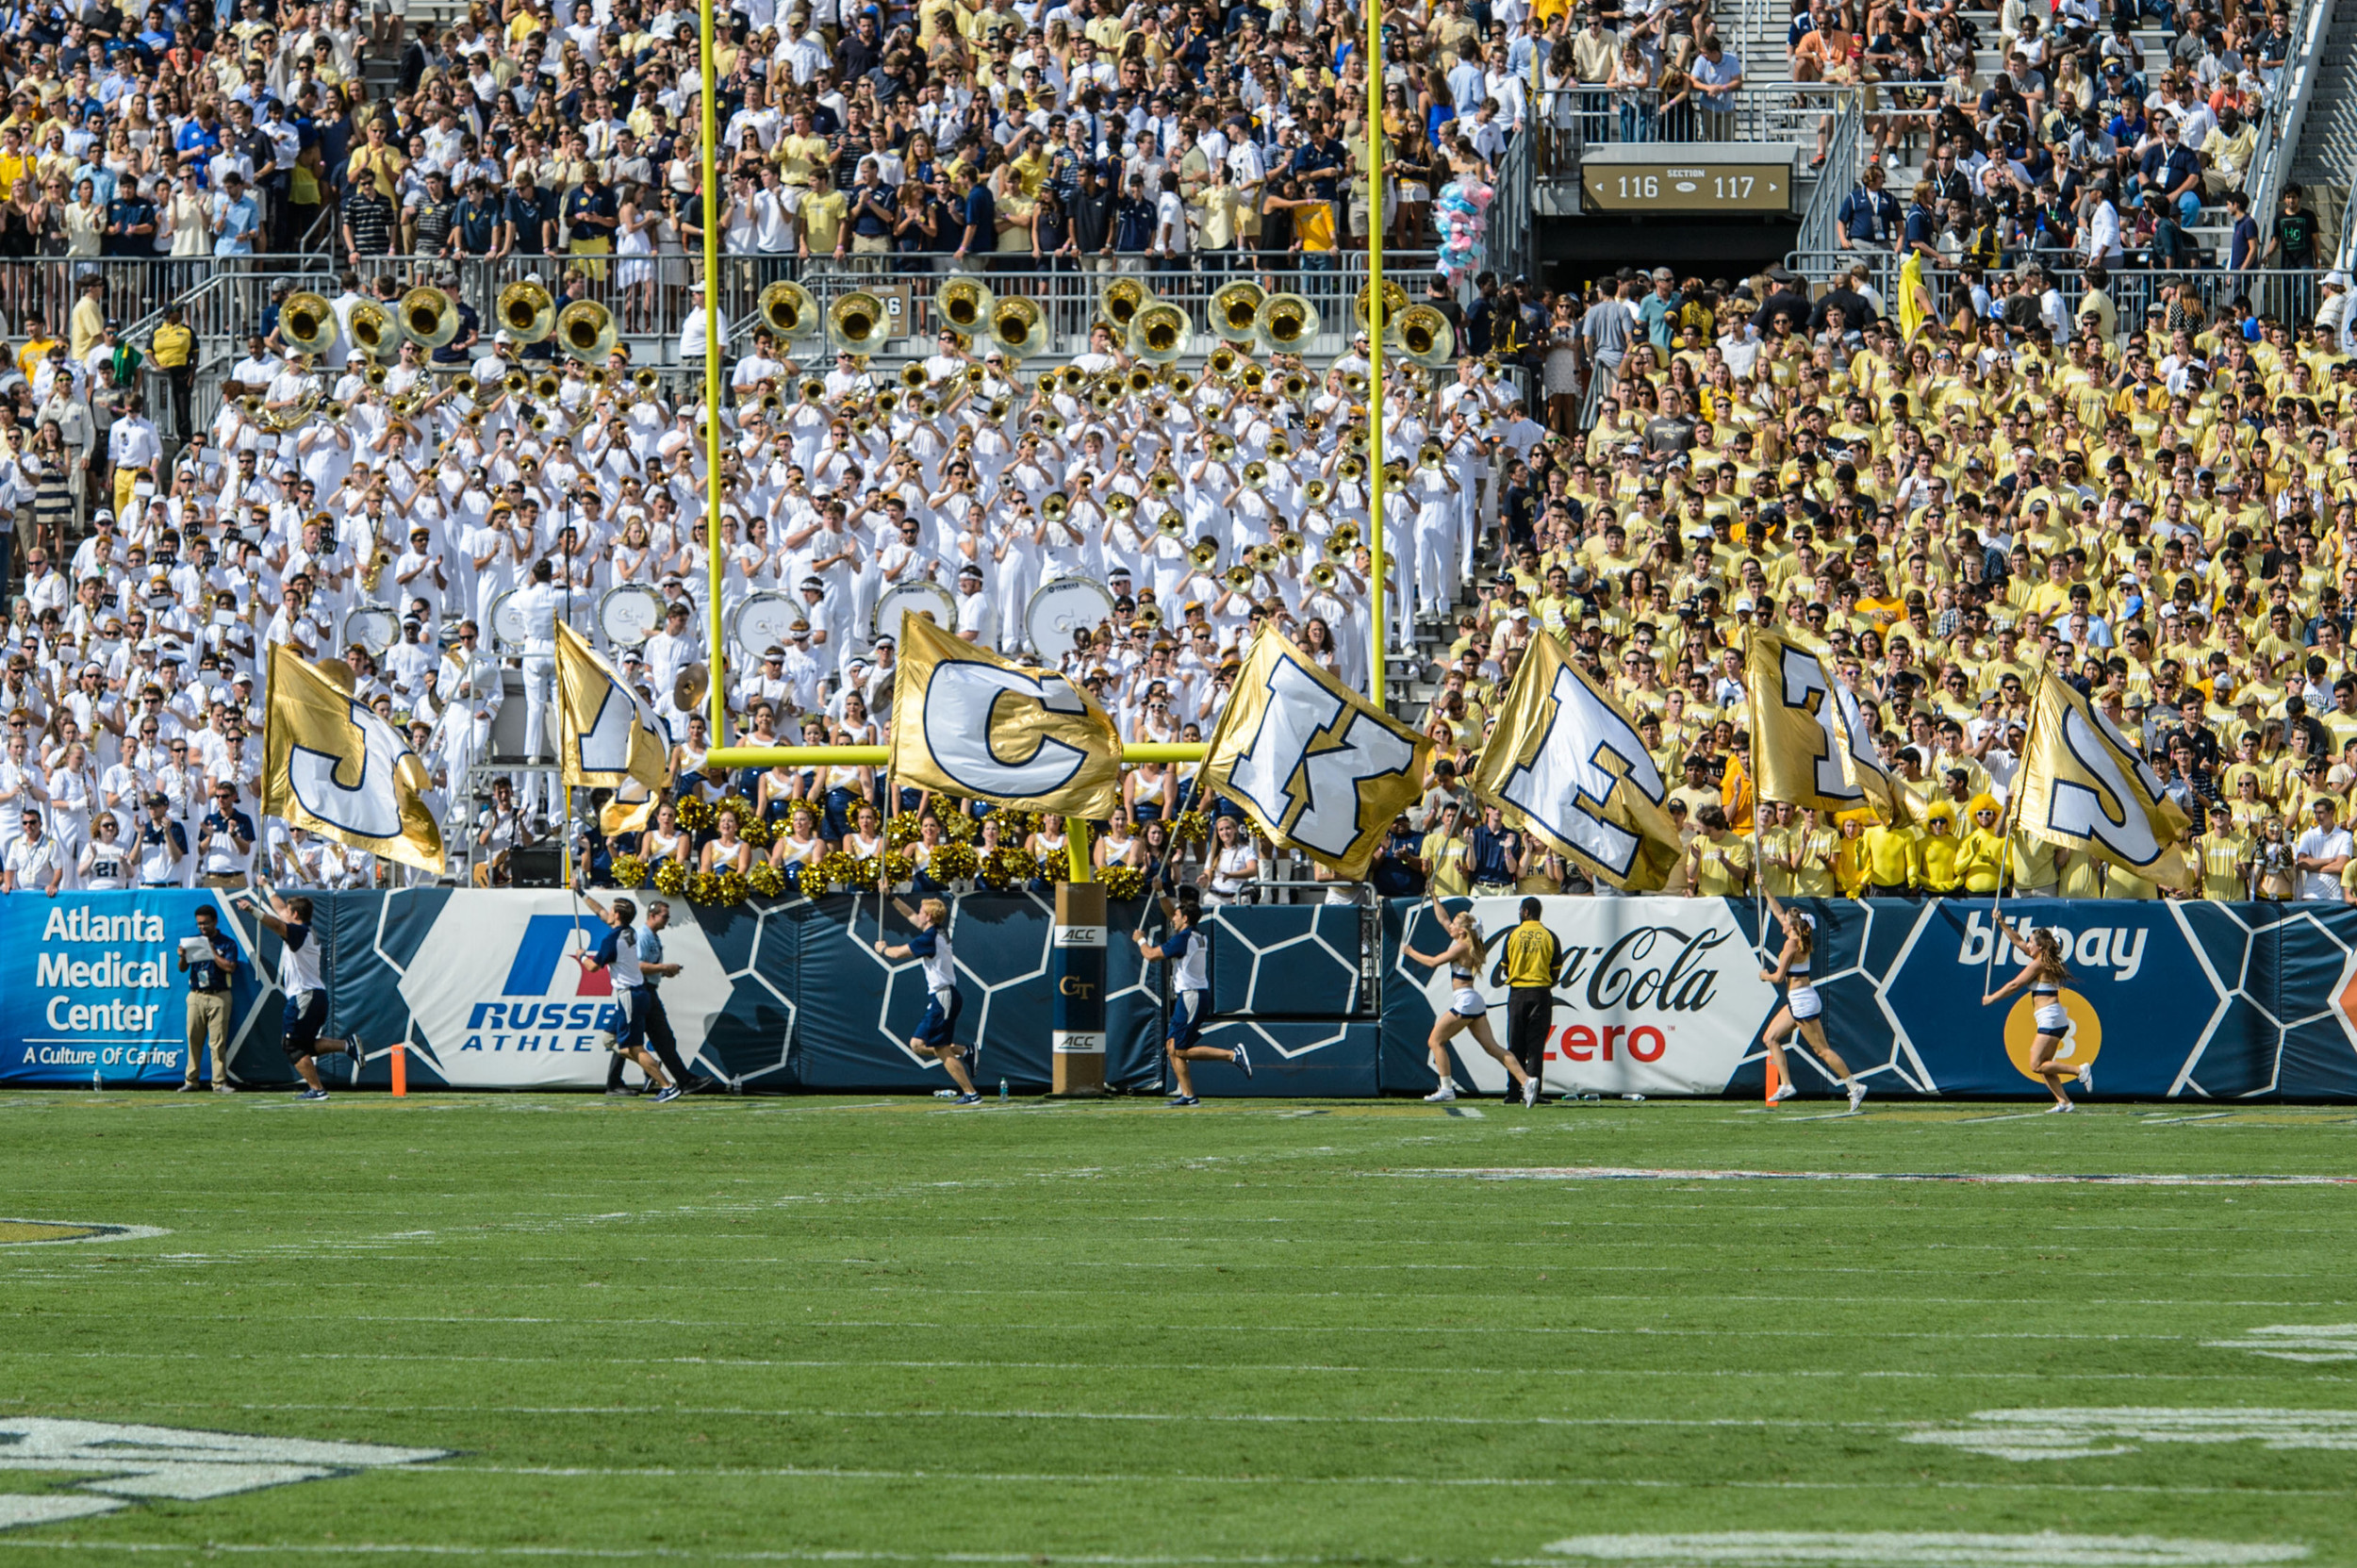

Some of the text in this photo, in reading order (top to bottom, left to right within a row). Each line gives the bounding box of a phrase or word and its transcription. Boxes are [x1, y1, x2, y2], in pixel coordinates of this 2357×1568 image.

[1618, 175, 1755, 199] 116 117
[1667, 169, 1705, 177] SECTION
[923, 658, 1089, 799] C
[288, 696, 415, 838] J
[1227, 652, 1416, 860] K
[1498, 662, 1666, 880] E
[2047, 697, 2166, 867] S
[94, 861, 118, 878] 21
[41, 905, 166, 944] Atlanta
[1063, 929, 1096, 940] ACC
[1520, 930, 1542, 941] CSC
[36, 950, 171, 989] Medical
[1486, 926, 1736, 1012] a-Cola
[1059, 975, 1095, 999] GT
[46, 995, 159, 1032] Center
[466, 1002, 618, 1030] RUSSE
[23, 1046, 177, 1068] A Culture Of Caring
[1062, 1035, 1096, 1047] ACC
